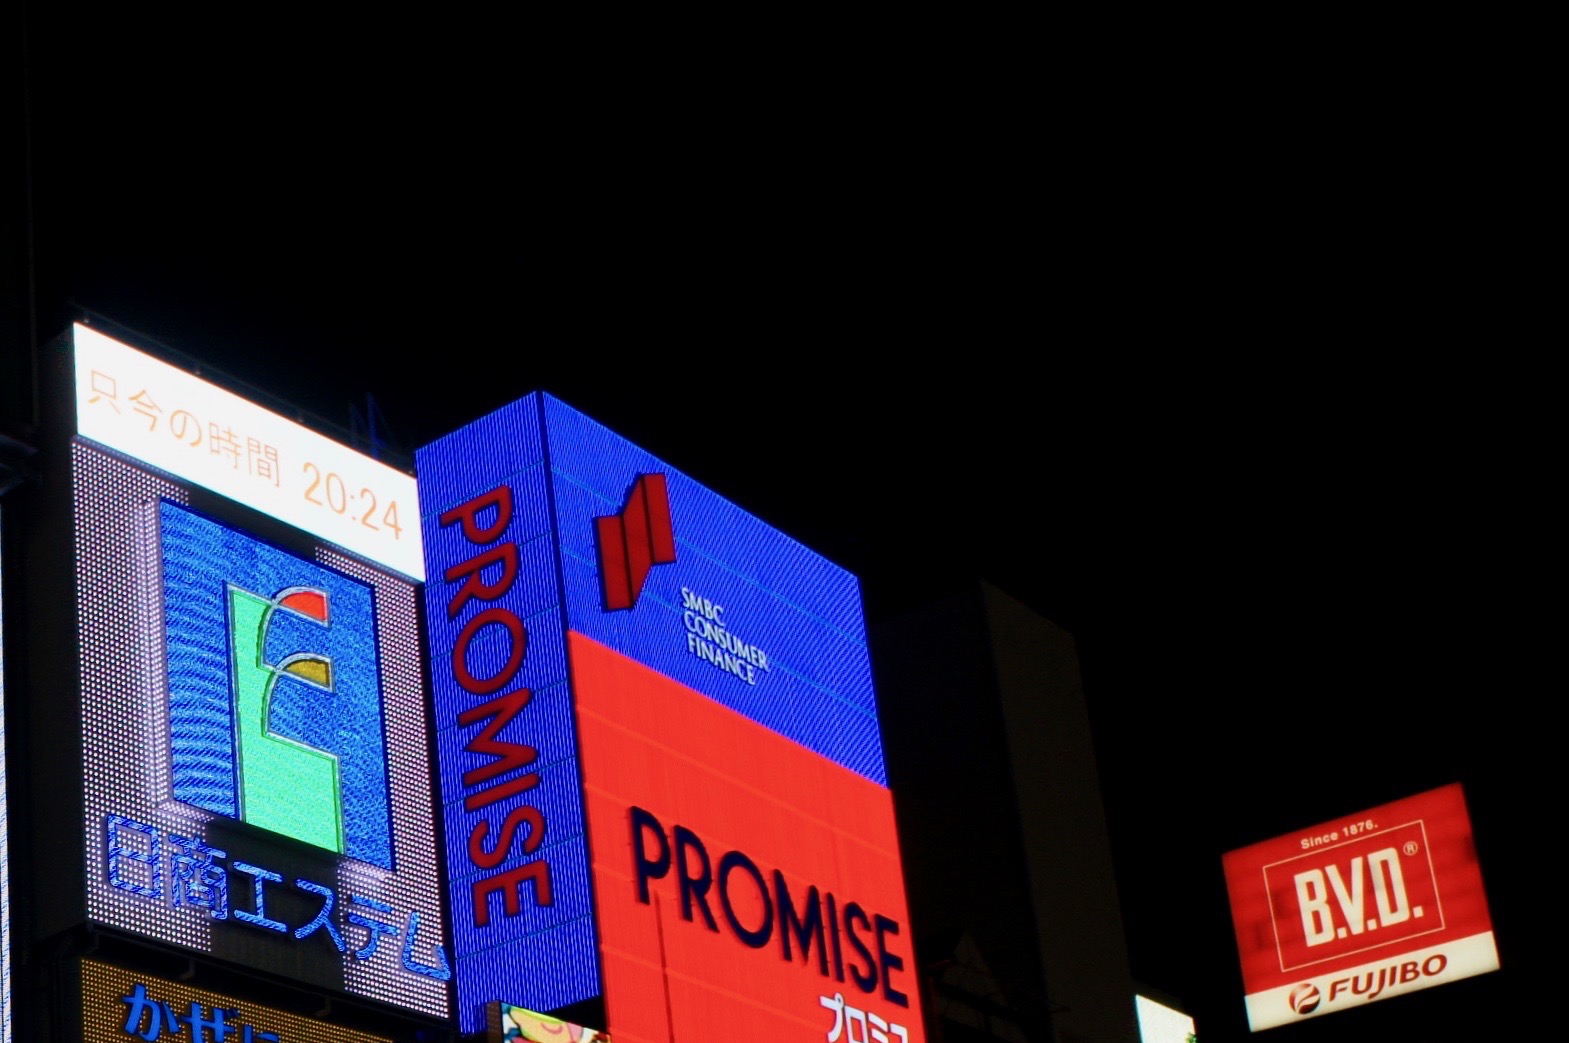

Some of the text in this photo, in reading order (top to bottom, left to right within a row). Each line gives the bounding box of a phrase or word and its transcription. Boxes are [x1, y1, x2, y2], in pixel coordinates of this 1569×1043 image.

[87, 369, 403, 541] 只今の時間 20:24
[681, 586, 725, 627] SMBC
[683, 610, 770, 673] CONSUMER
[687, 633, 756, 687] FINANCE
[439, 483, 554, 928] PROMISE
[1300, 819, 1379, 850] Since 1876.
[106, 814, 452, 982] 日商エステム
[629, 805, 910, 1009] PROMISE
[1293, 846, 1425, 948] B.V.D.
[1329, 953, 1448, 1002] FUJIBO
